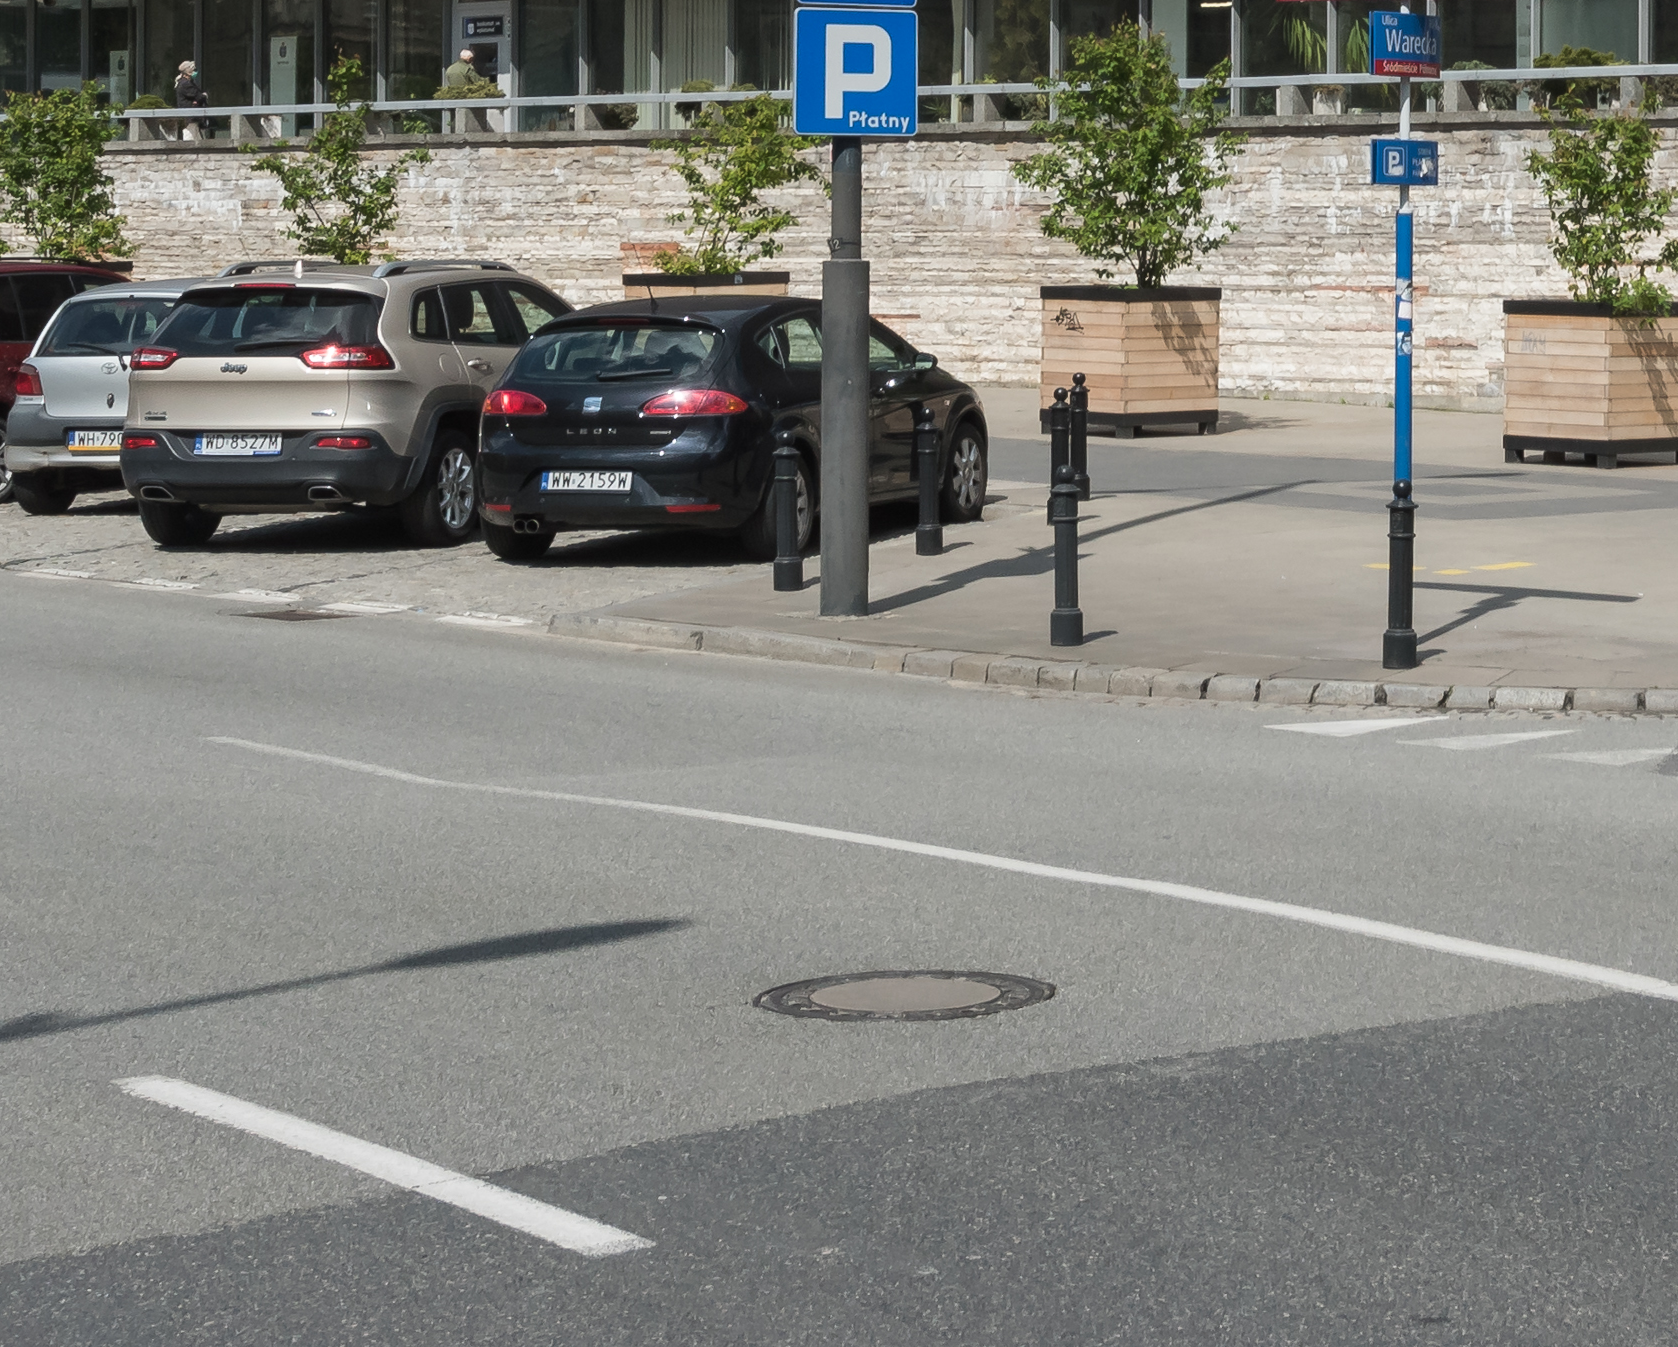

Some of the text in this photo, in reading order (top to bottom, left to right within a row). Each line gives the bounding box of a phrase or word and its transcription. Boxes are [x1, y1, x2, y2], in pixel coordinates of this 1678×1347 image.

[1382, 14, 1398, 25] Ulica
[1385, 28, 1437, 55] Warecka
[825, 24, 892, 119] P
[849, 111, 910, 133] Płatny
[220, 362, 248, 374] Jeep
[566, 427, 617, 435] LEON
[205, 433, 278, 449] WD 8527M
[552, 472, 628, 489] WW 2159W
